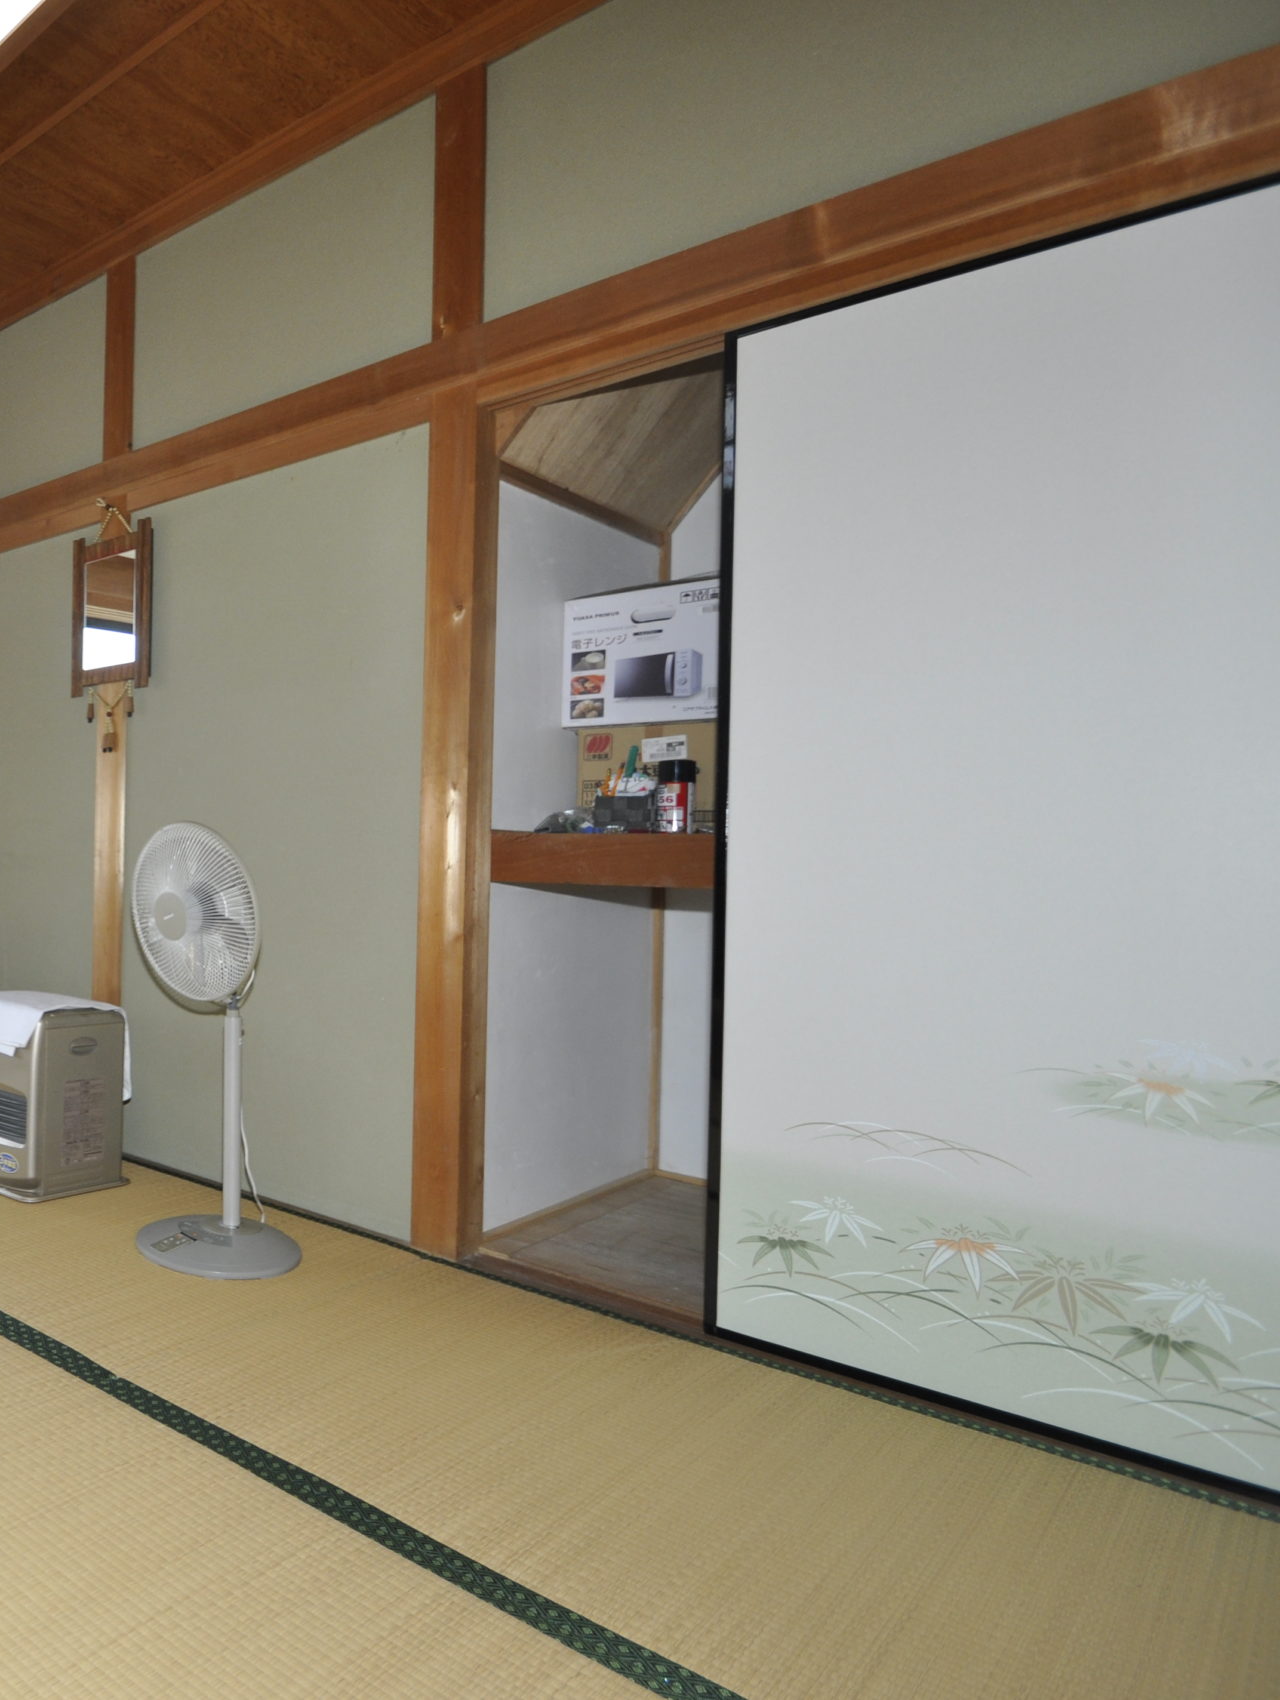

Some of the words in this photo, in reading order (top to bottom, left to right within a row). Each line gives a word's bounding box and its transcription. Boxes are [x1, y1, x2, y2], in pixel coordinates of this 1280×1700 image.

[571, 633, 628, 650] 電子レンジ
